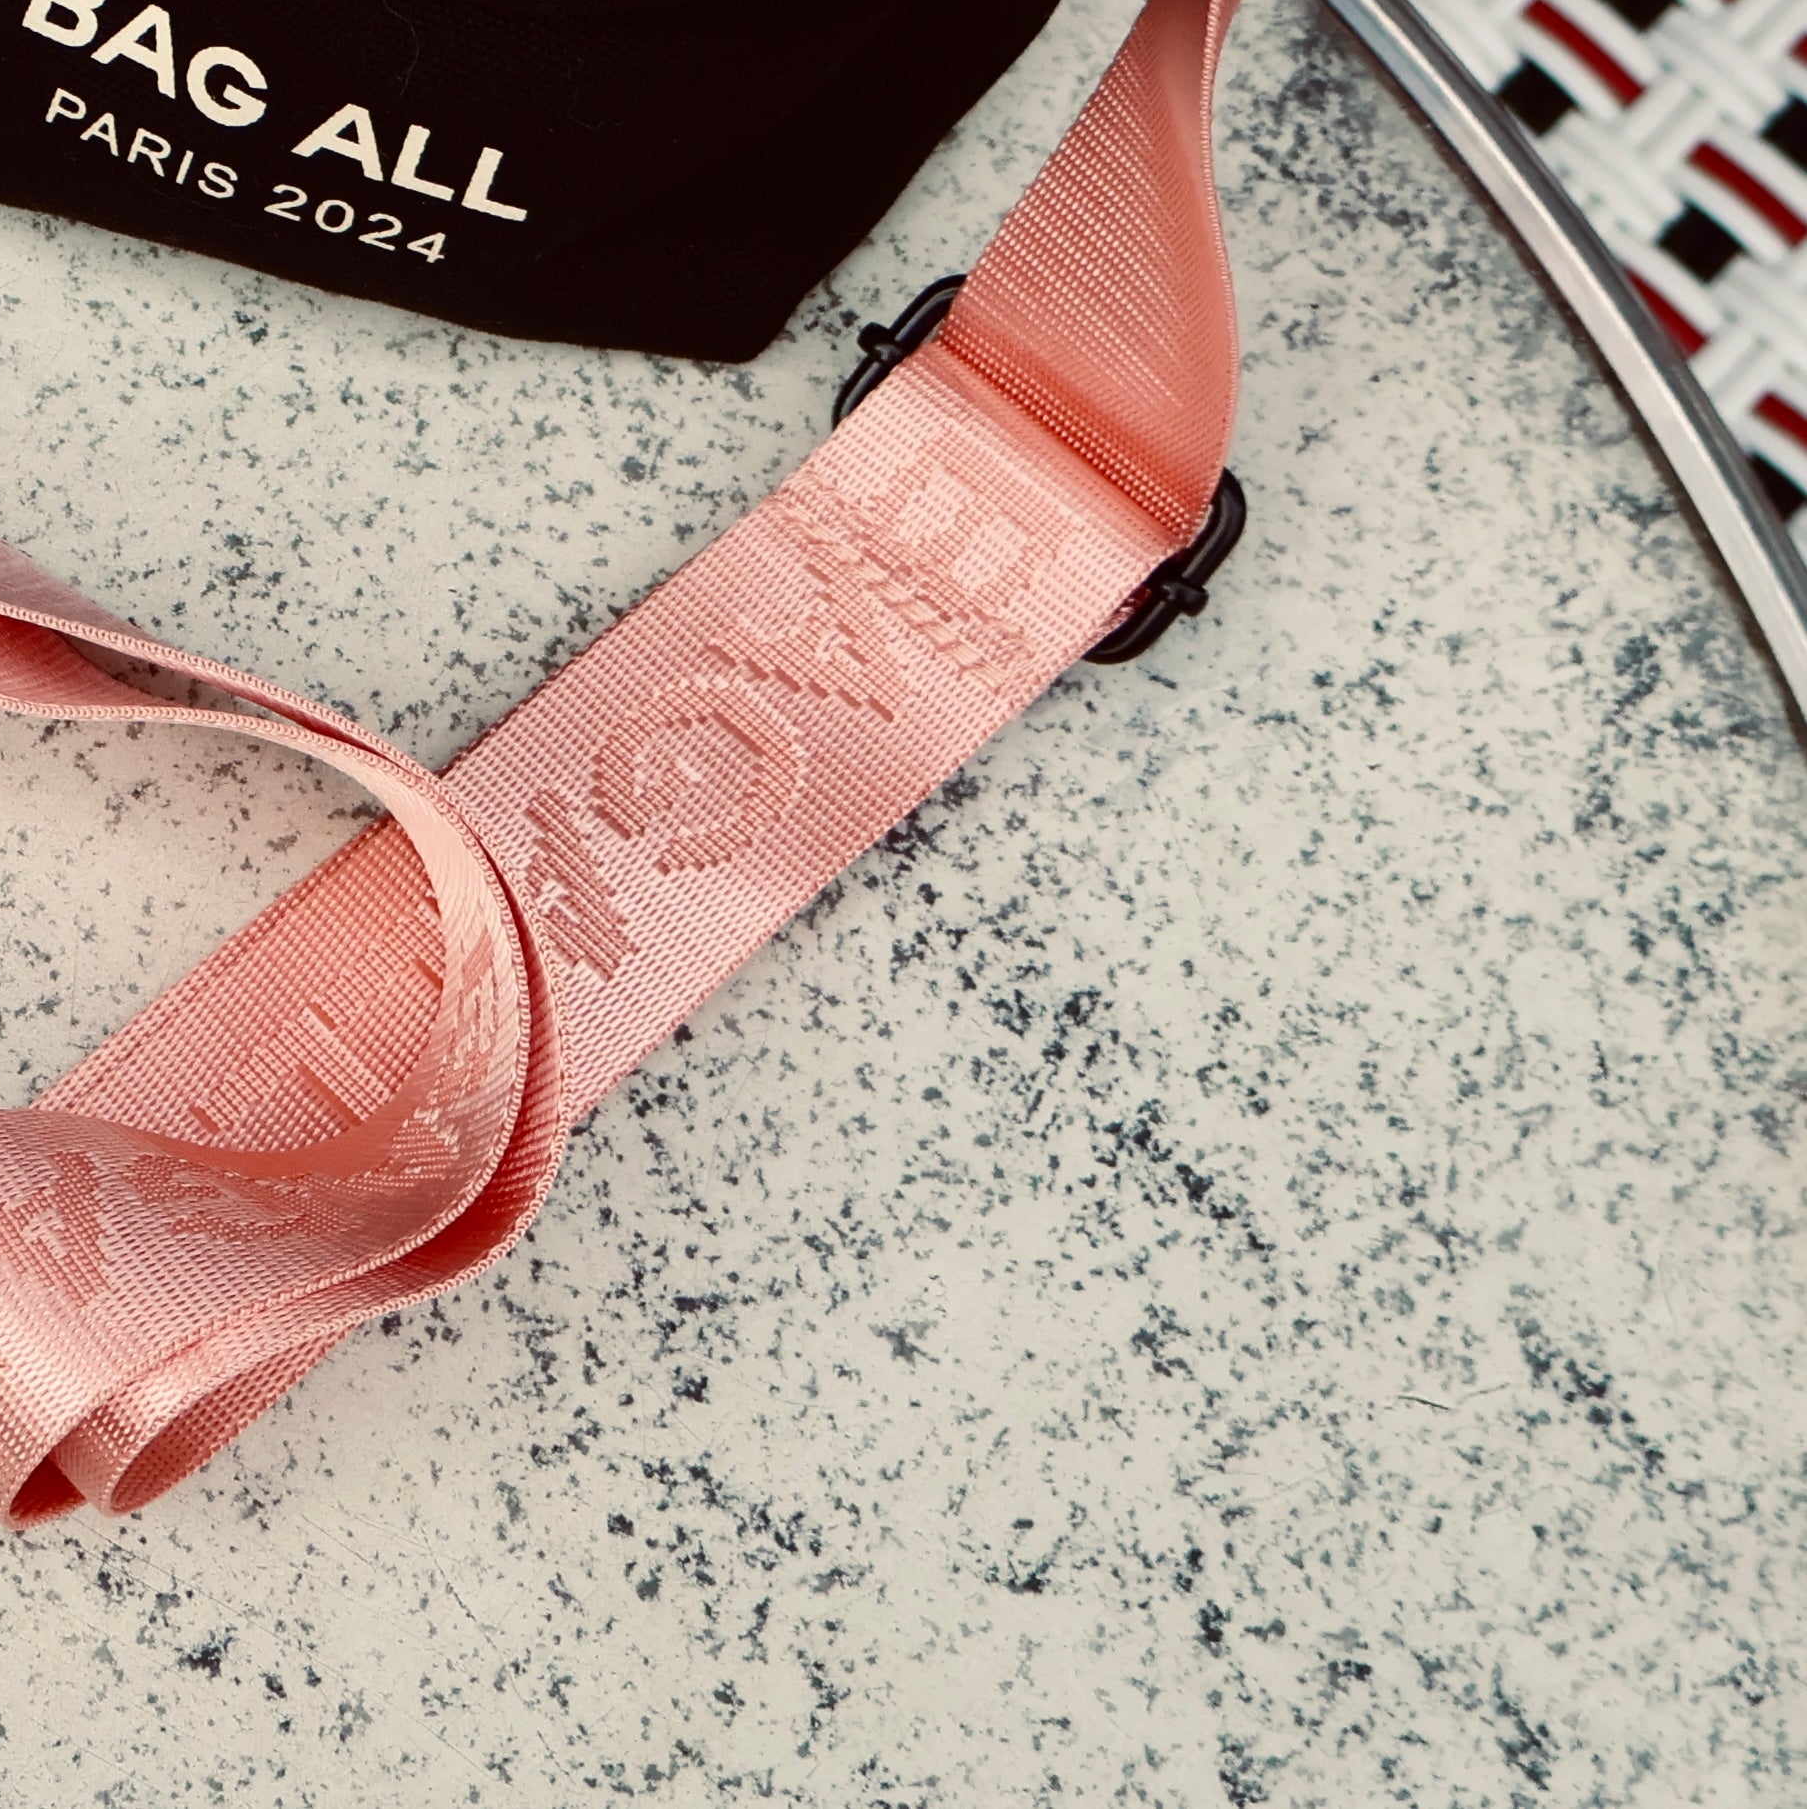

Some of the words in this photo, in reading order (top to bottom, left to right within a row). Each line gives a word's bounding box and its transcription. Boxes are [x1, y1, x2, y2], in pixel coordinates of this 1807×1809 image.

[45, 87, 239, 199] PARIS
[263, 184, 447, 264] 2024
[291, 103, 528, 222] ALL
